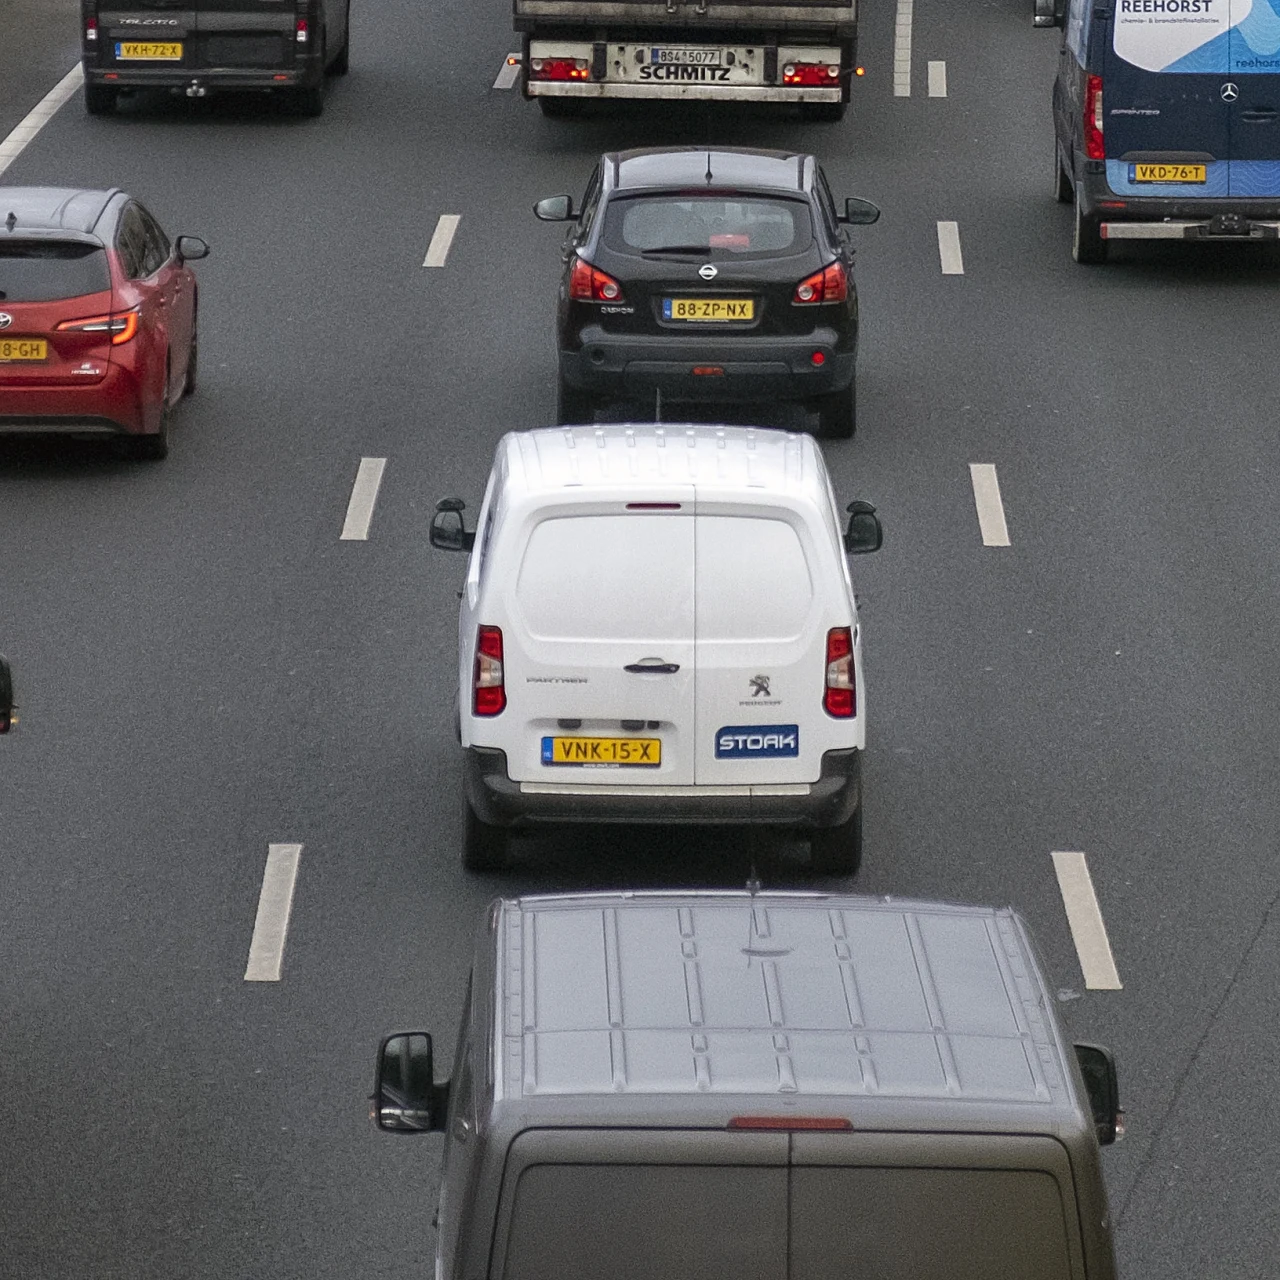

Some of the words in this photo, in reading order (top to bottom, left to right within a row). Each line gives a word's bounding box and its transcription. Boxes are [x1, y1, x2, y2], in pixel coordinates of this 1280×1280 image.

[1121, 0, 1213, 14] REEHORST
[122, 44, 178, 57] VKH-72-X
[688, 51, 715, 63] 5077
[640, 65, 731, 81] SCHMITZ
[1139, 166, 1201, 179] VKD-76-T
[677, 302, 747, 316] 88-ZP-NX
[719, 734, 796, 750] STORK
[561, 741, 651, 760] VNK-15-X
